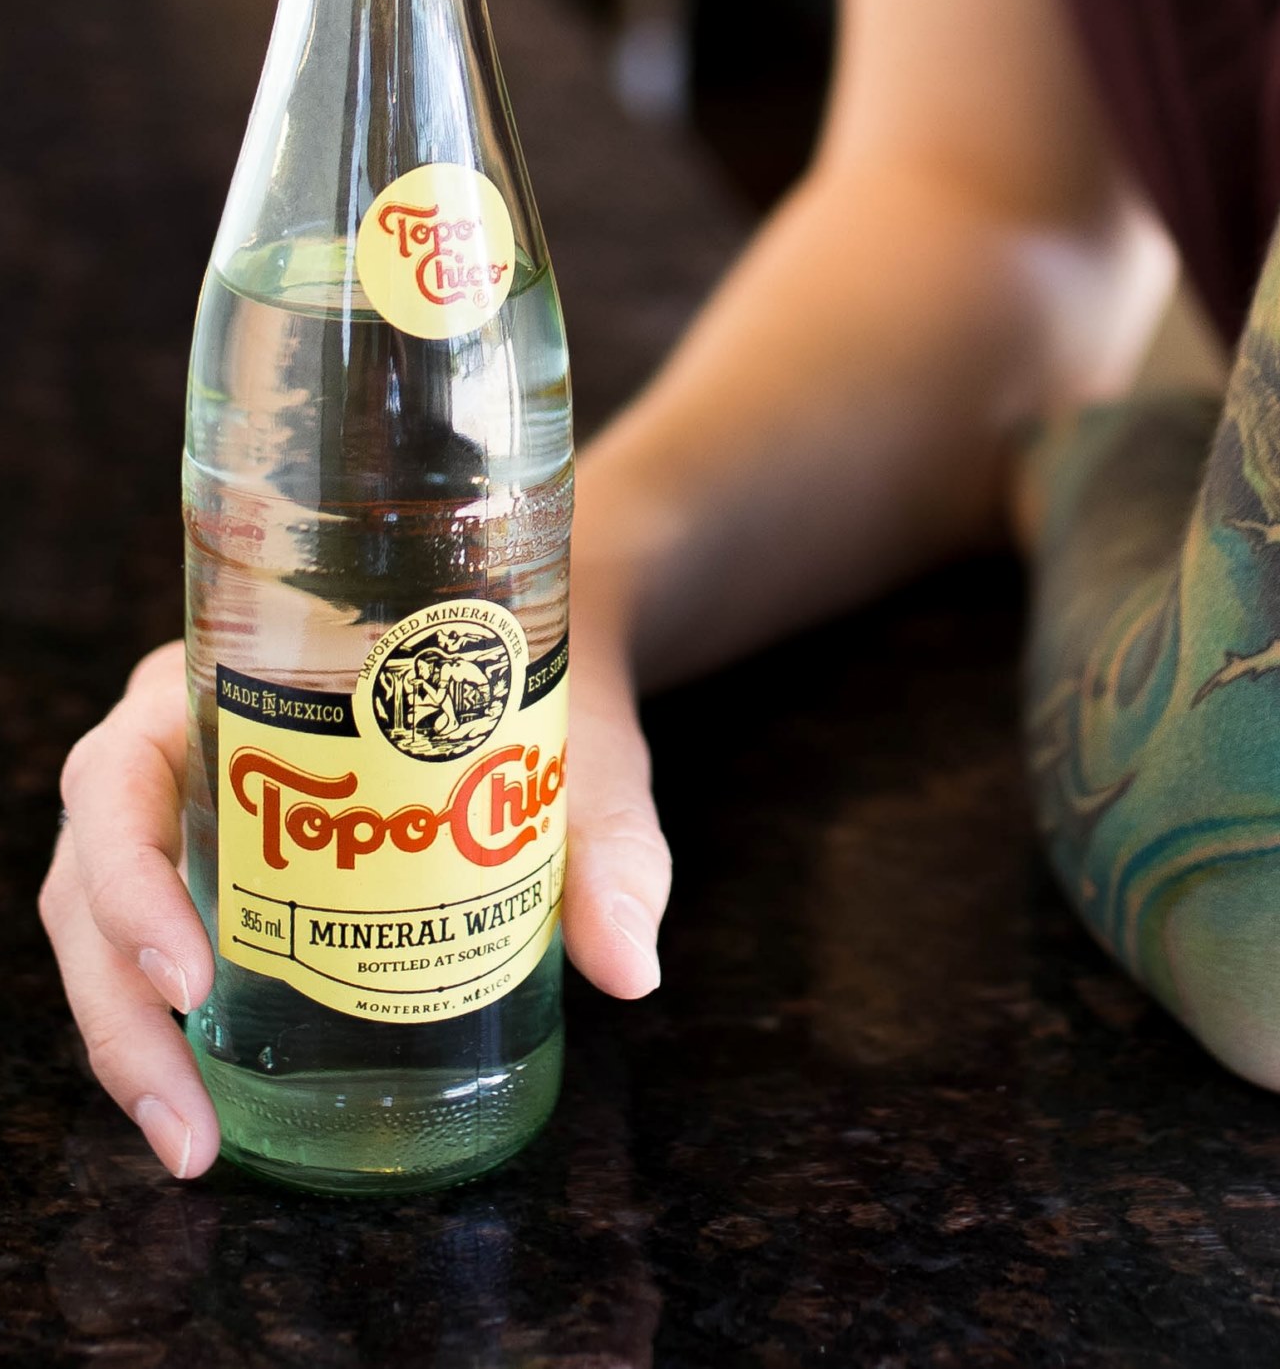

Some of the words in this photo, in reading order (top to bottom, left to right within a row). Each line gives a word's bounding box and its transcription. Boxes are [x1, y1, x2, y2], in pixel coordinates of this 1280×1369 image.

[378, 201, 481, 258] Topo
[415, 249, 508, 305] Chico
[358, 619, 420, 681] IMPORTED
[426, 607, 496, 625] MINERAL
[498, 618, 523, 659] WATER
[221, 679, 260, 708] MADE
[279, 698, 344, 723] MEXICO
[528, 667, 550, 693] EST.
[229, 745, 442, 870] Topo
[240, 907, 263, 931] 355
[308, 918, 456, 950] MINERAL
[463, 880, 544, 937] WATER
[357, 958, 431, 973] BOTTLED
[434, 954, 455, 967] AT
[457, 935, 512, 963] SOURCE
